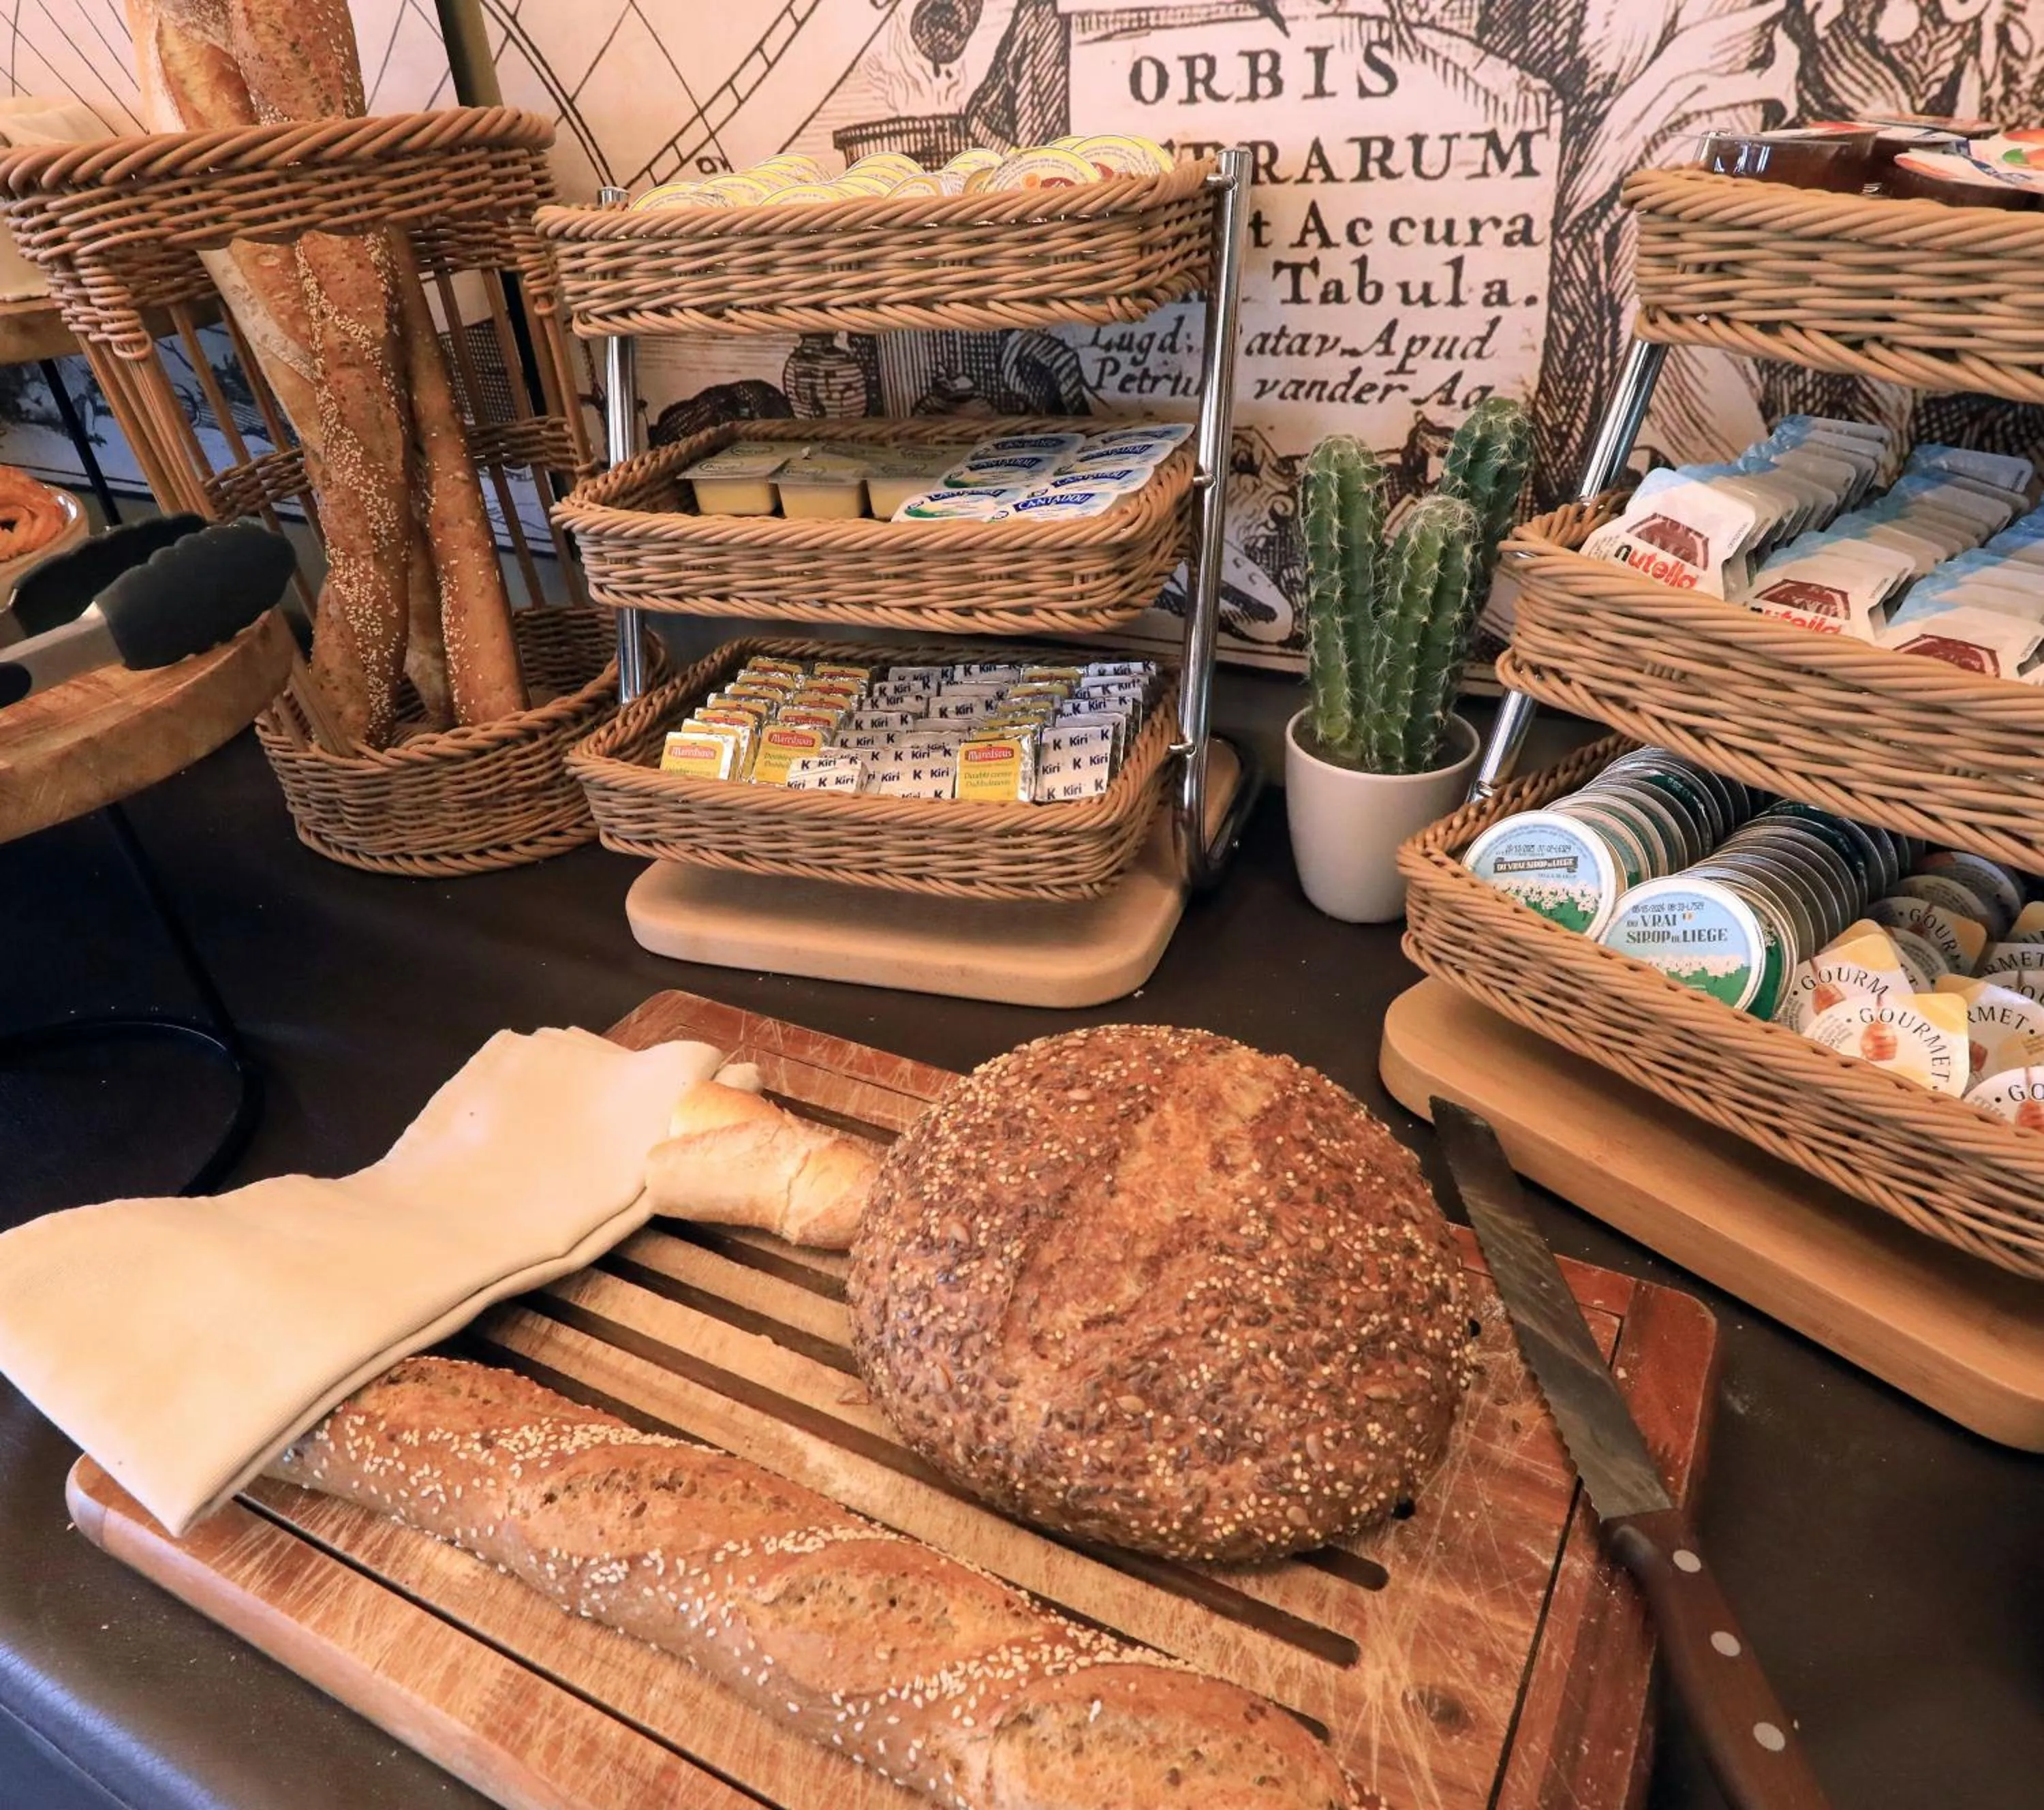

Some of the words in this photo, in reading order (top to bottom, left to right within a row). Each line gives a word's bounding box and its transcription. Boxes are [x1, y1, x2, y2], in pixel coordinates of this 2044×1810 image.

[1128, 40, 1399, 105] ORBIS
[1237, 129, 1550, 185] RARUM
[1248, 209, 1273, 247] t
[1289, 200, 1545, 249] Accura
[1273, 254, 1540, 307] Tabula.
[1340, 316, 1502, 376] Apud
[1092, 356, 1201, 397] Petru
[1254, 366, 1409, 405] vander
[1018, 494, 1091, 510] CANTADOU
[1614, 544, 1698, 589] nutella
[893, 685, 911, 694] Kiri
[871, 699, 878, 709] K
[886, 695, 903, 706] Kiri
[955, 703, 973, 716] Kiri
[1072, 703, 1081, 714] K
[1088, 698, 1106, 711] Kiri
[855, 720, 863, 731] K
[871, 717, 888, 728] Kiri
[900, 714, 908, 725] K
[840, 739, 848, 748] K
[856, 736, 874, 746] Kiri
[886, 733, 895, 743] K
[1053, 739, 1062, 751] K
[1070, 734, 1087, 747] Kiri
[1100, 729, 1109, 741] K
[801, 760, 810, 769] K
[818, 758, 836, 767] Kiri
[871, 751, 880, 761] K
[894, 751, 903, 761] K
[912, 750, 929, 759] Kiri
[1042, 763, 1059, 775] Kiri
[1073, 758, 1081, 770] K
[1090, 753, 1108, 765] Kiri
[818, 778, 826, 787] K
[835, 776, 854, 784] Kiri
[882, 771, 899, 782] Kiri
[914, 769, 922, 780] K
[931, 767, 948, 778] Kiri
[1047, 788, 1055, 799] K
[1064, 783, 1081, 796] Kiri
[1095, 779, 1103, 791] K
[1640, 914, 1677, 927] VRAI
[1626, 930, 1671, 944] SIROP
[1801, 967, 1889, 996] GOURM
[1859, 1007, 1951, 1082] GOURMET
